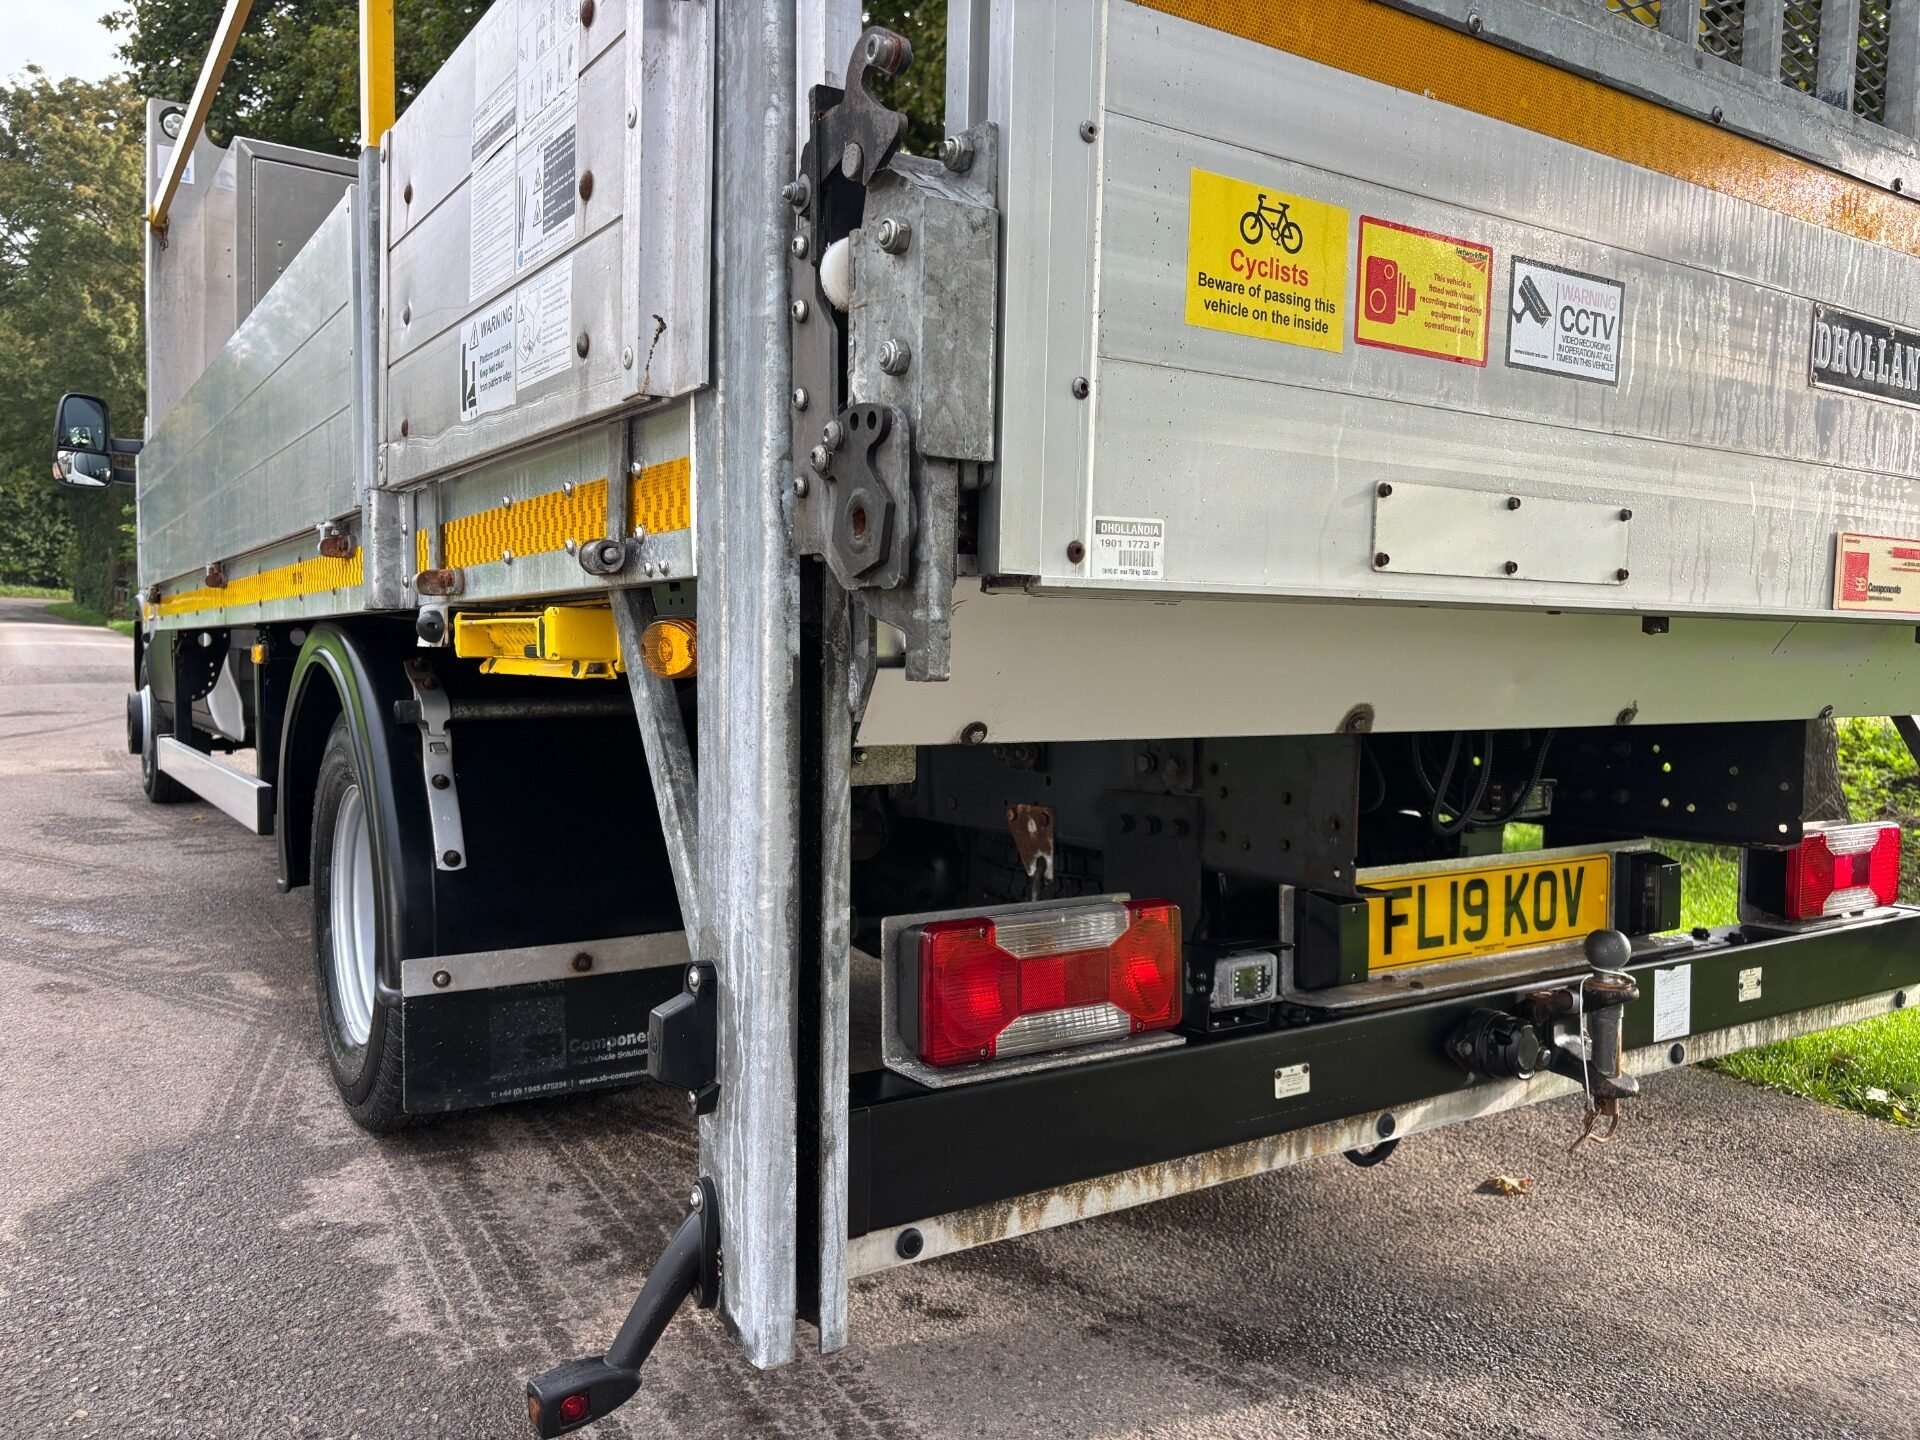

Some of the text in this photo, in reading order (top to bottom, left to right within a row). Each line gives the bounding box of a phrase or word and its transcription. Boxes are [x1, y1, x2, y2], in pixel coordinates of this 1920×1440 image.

[1230, 248, 1309, 287] Cyclists
[1434, 272, 1472, 289] This vehicle is
[1198, 271, 1336, 314] Beware of passing this
[1428, 283, 1444, 294] fitted
[1445, 288, 1458, 298] with
[1561, 283, 1617, 312] WARNING
[1420, 295, 1448, 309] recording
[1448, 300, 1461, 310] and
[480, 304, 513, 338] WARNING
[1204, 298, 1329, 334] vehicle on the inside
[1560, 305, 1616, 341] CCTV
[1424, 320, 1457, 333] operational
[1558, 343, 1613, 363] IN OPERATION AT ALL
[1561, 335, 1612, 352] VIDEO RECORDING
[1556, 353, 1573, 365] TIMES
[1573, 357, 1579, 367] IN
[1579, 358, 1592, 368] THIS
[1592, 360, 1615, 372] VEHICLE
[1100, 522, 1160, 536] DHOLLANDIA
[1100, 539, 1160, 549] 1901 1773 P
[1868, 582, 1901, 594] Components
[1384, 866, 1585, 955] FL19 KOV
[568, 1031, 649, 1052] Compone
